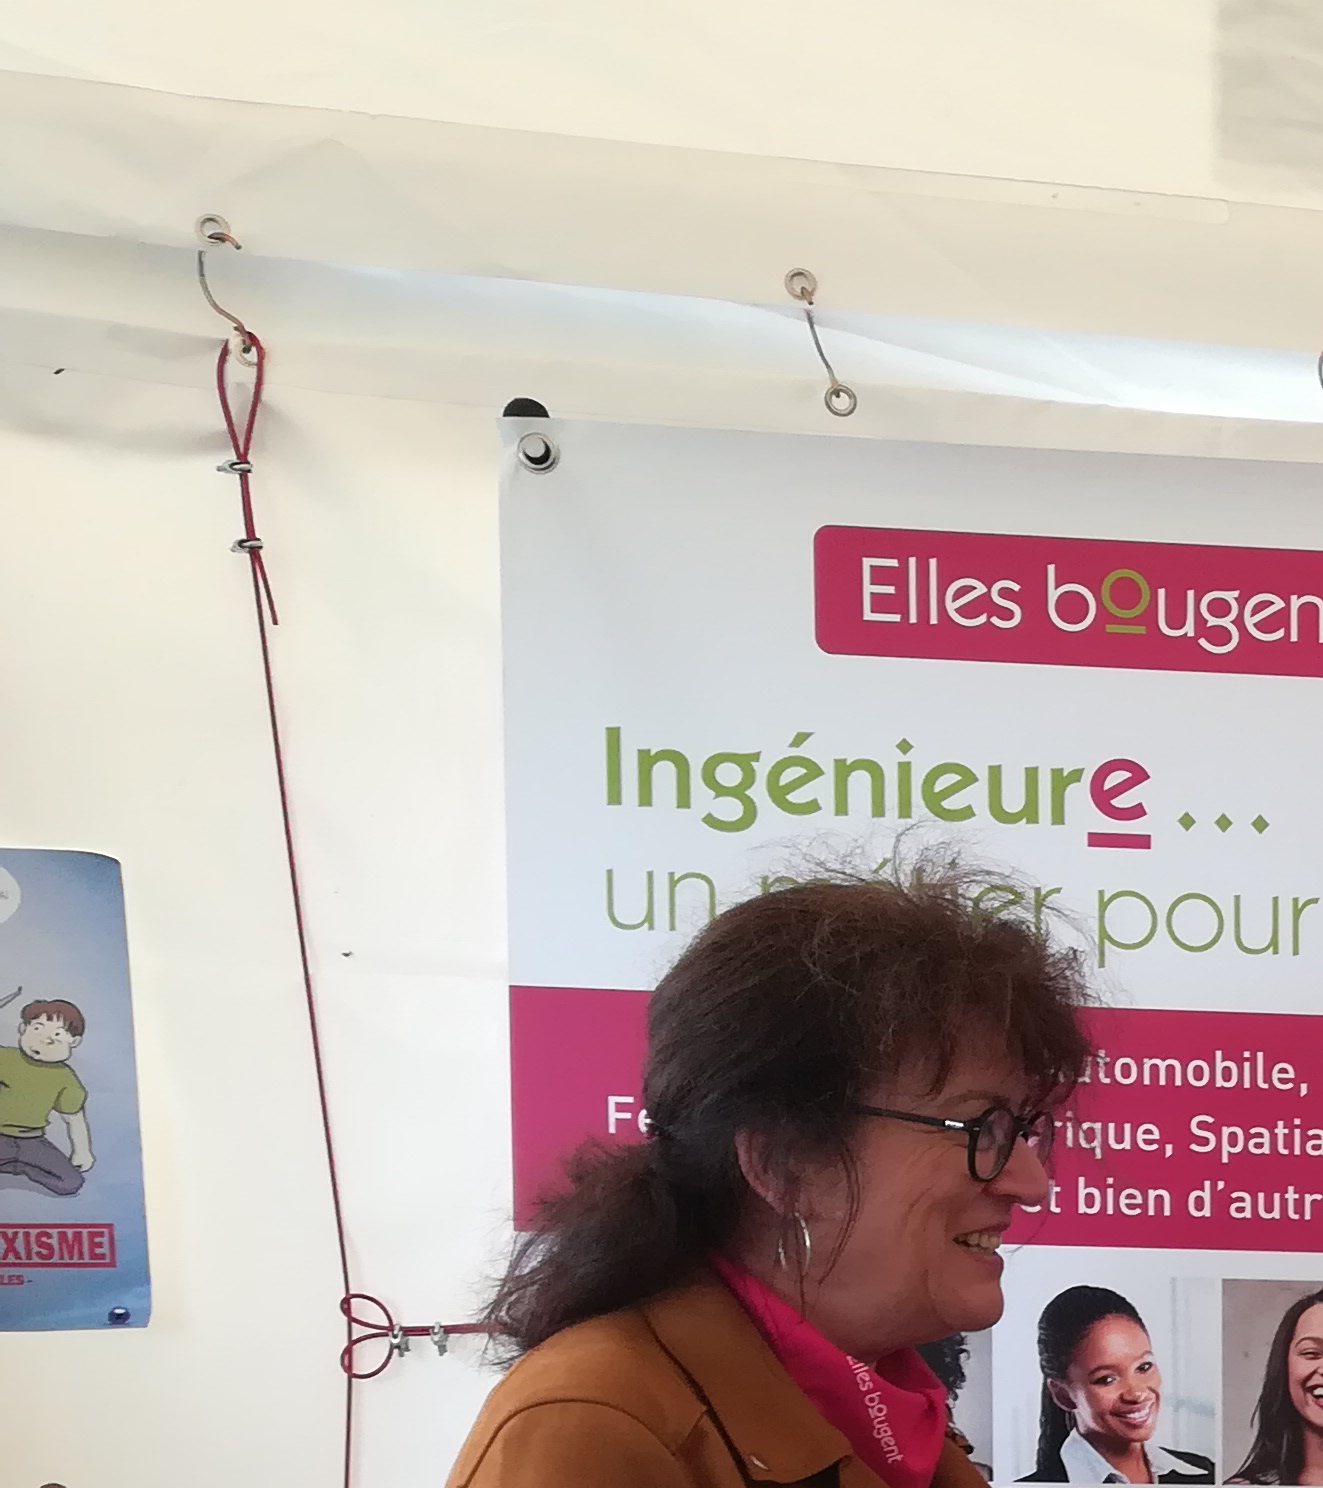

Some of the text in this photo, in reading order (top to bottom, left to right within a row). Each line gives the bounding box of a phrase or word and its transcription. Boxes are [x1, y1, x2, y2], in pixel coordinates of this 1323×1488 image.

[860, 555, 1022, 629] Elles
[604, 866, 718, 932] un
[1097, 885, 1322, 971] pour
[1050, 1049, 1309, 1098] utomobile,
[1019, 1179, 1062, 1214] t
[1077, 1176, 1171, 1216] bien
[865, 1391, 904, 1464] bougent
